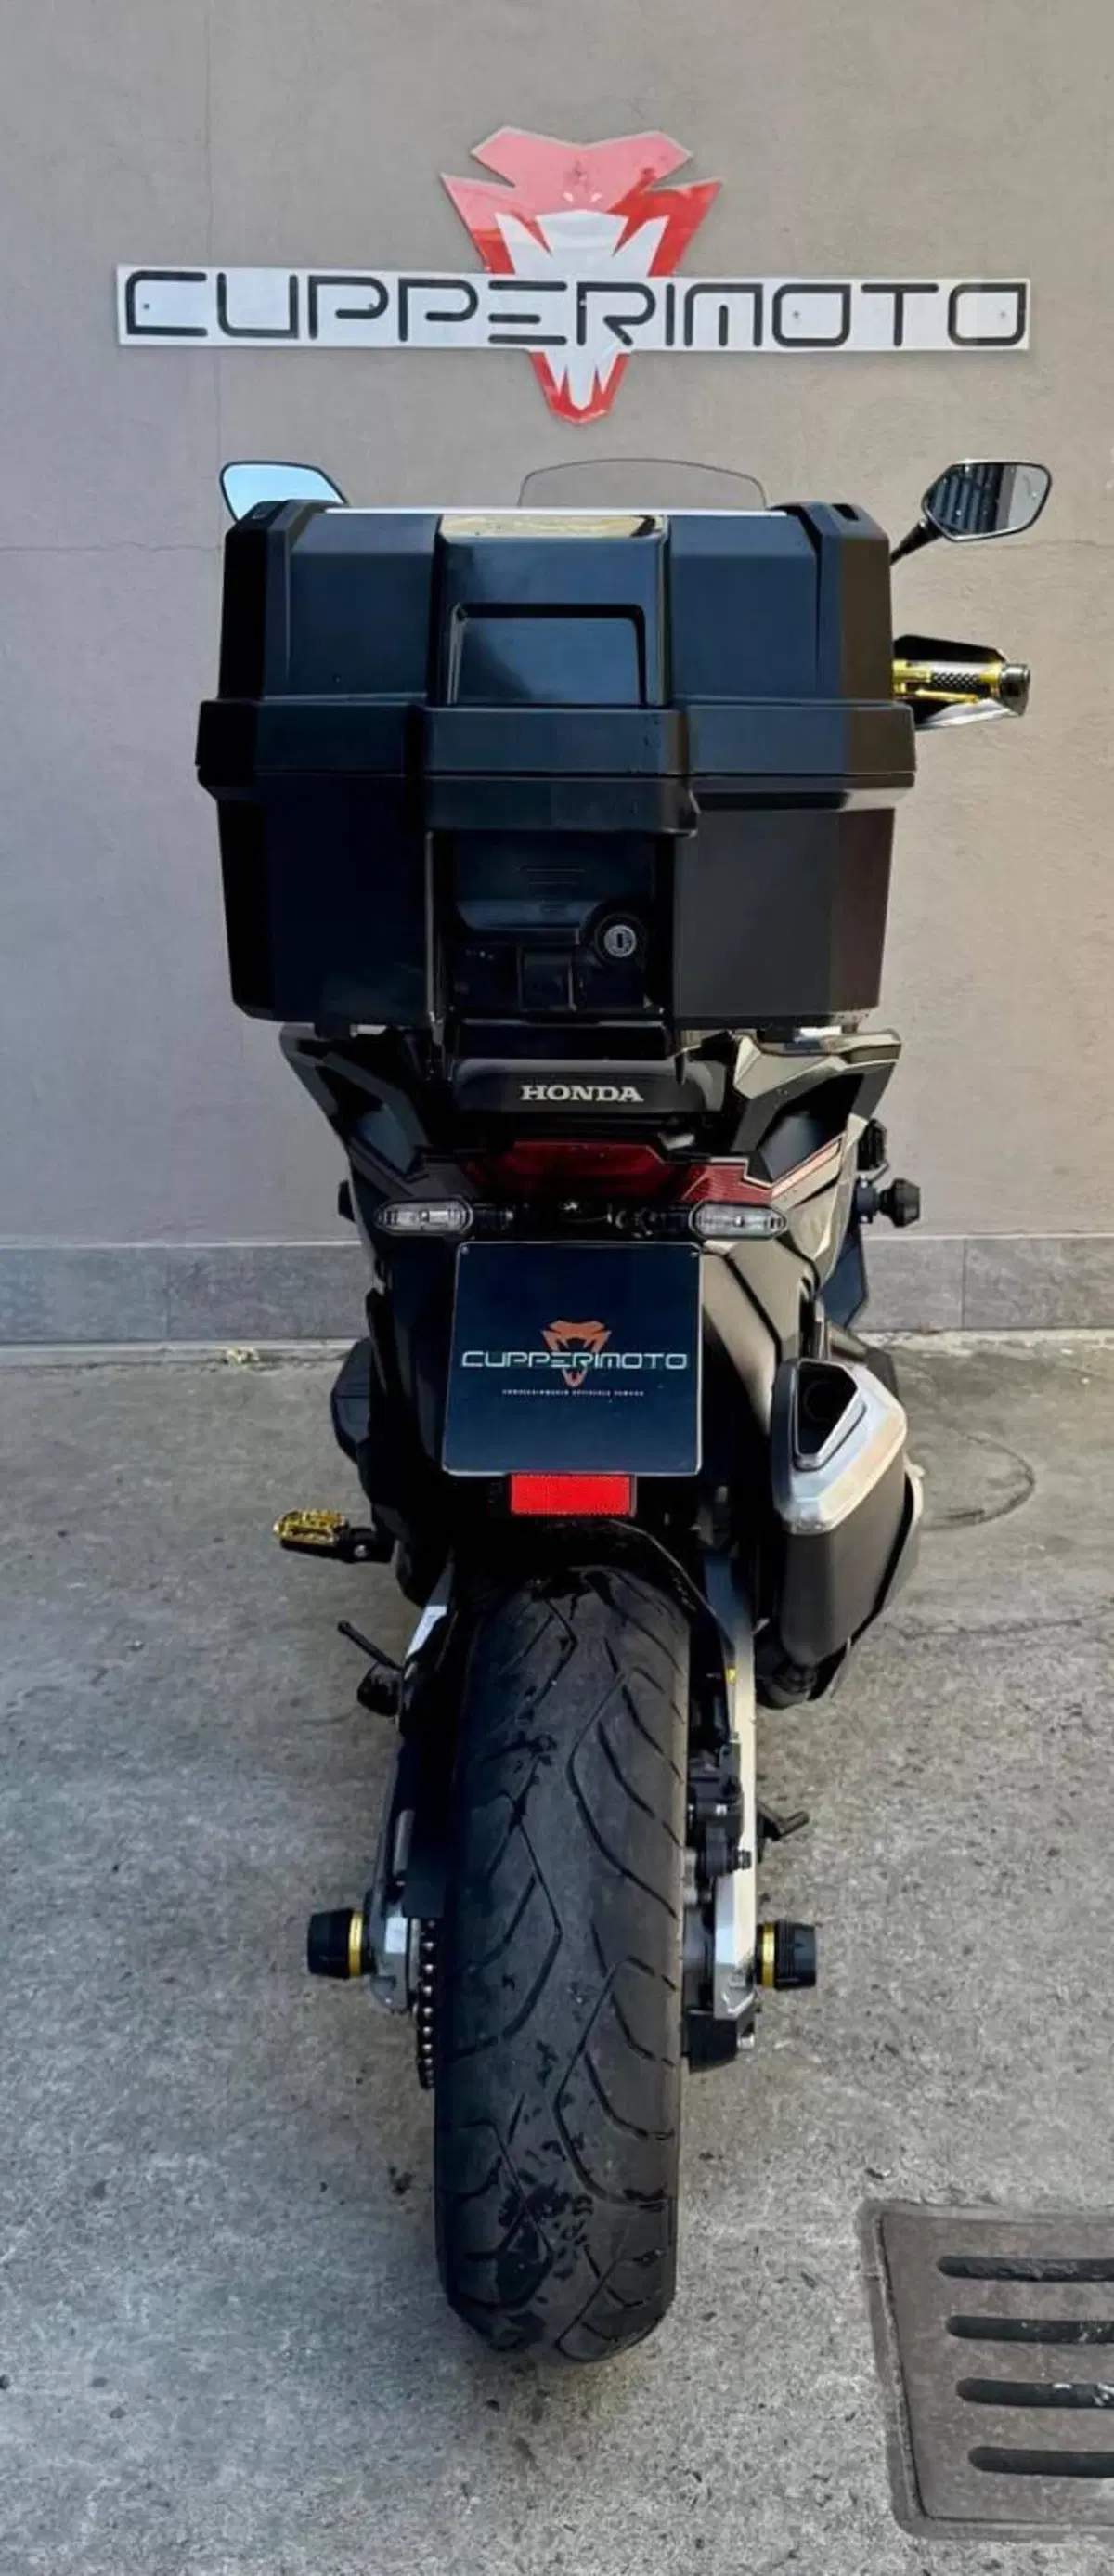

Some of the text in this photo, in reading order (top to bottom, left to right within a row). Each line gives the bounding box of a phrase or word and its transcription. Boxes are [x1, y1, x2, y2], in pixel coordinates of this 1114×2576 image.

[124, 269, 1028, 347] CUPPERIMOTO
[520, 1085, 644, 1102] HONDA
[461, 1350, 688, 1370] CUPPERIMOTO
